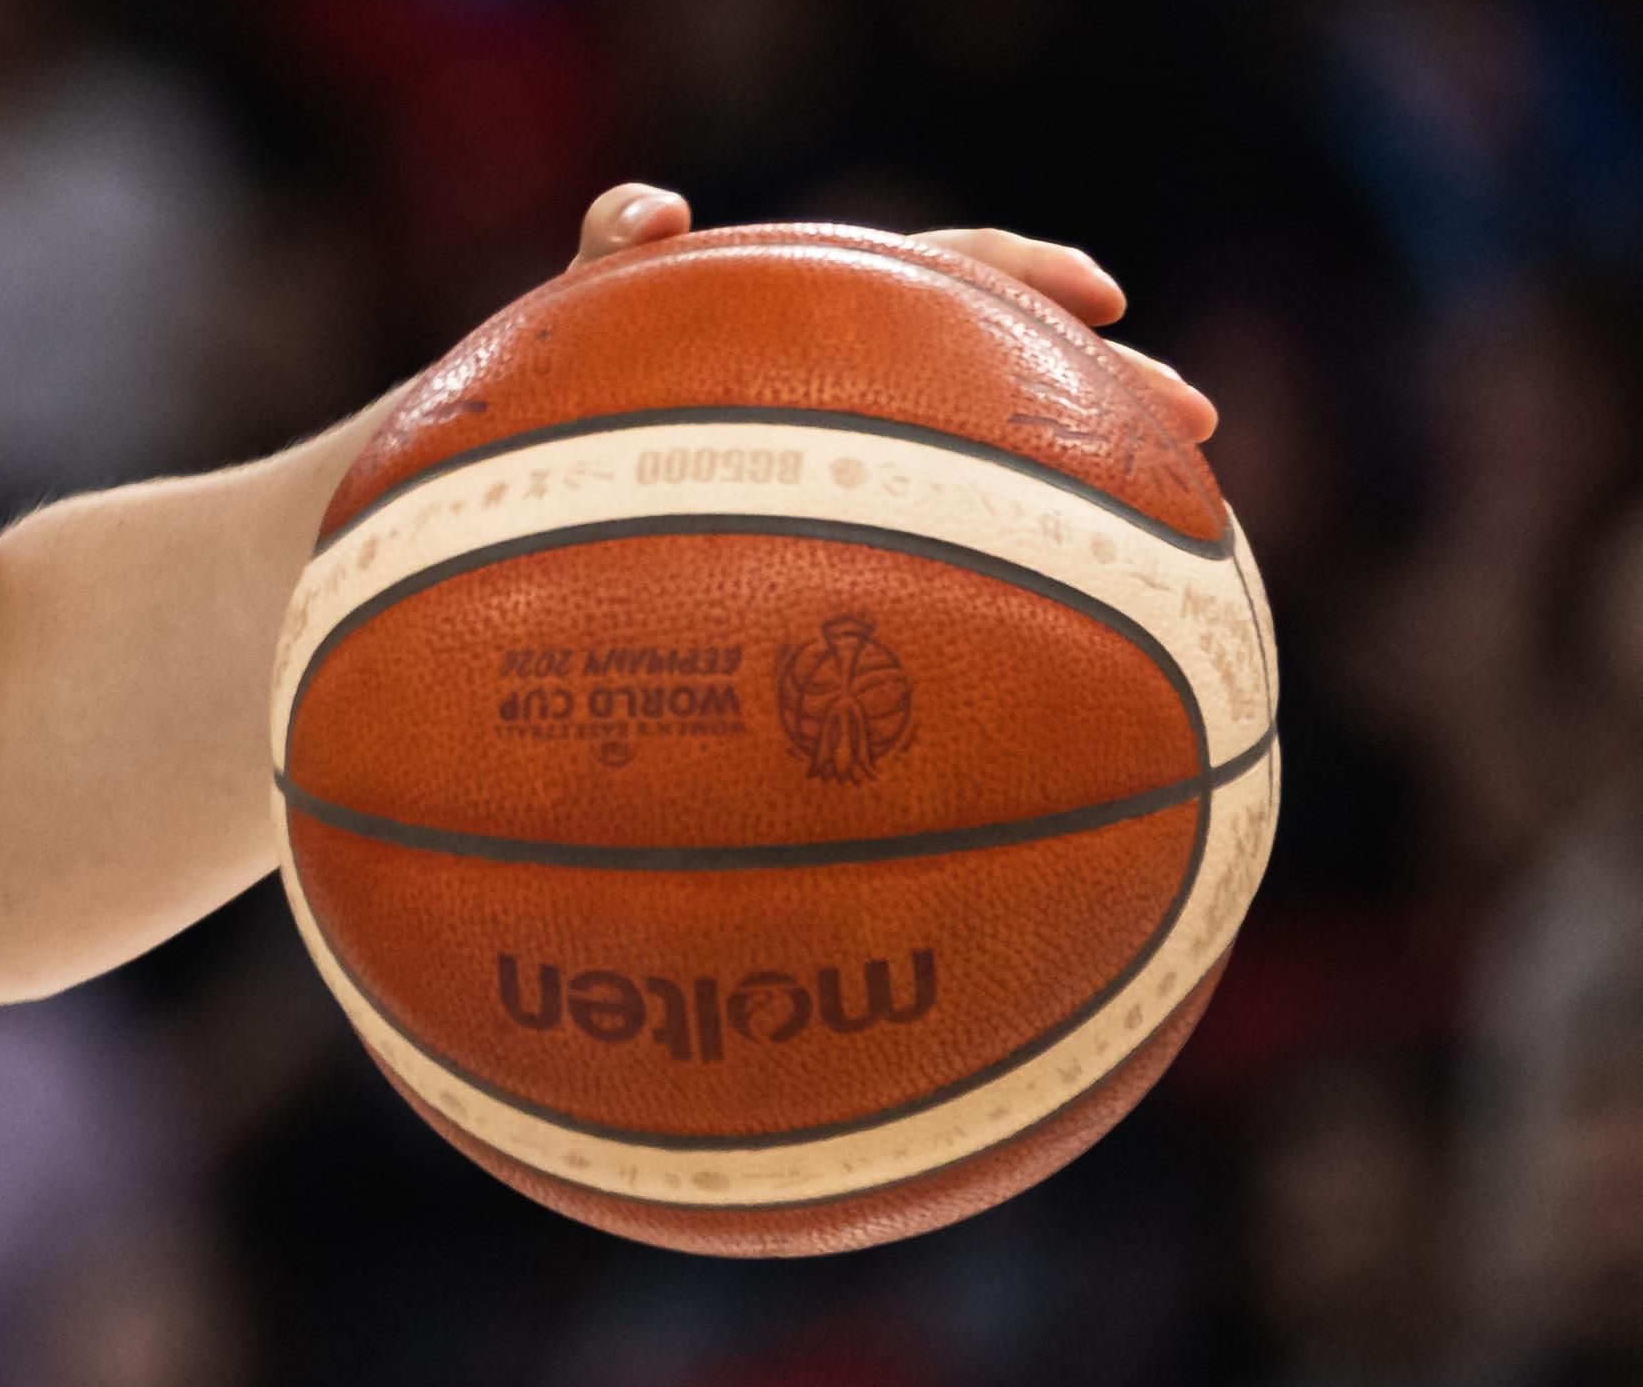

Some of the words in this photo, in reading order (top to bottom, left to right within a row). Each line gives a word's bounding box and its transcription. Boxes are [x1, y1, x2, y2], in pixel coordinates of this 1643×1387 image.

[635, 448, 805, 486] BG5000
[499, 686, 574, 722] CUP
[587, 683, 741, 719] WORLD
[497, 948, 938, 1063] molten
